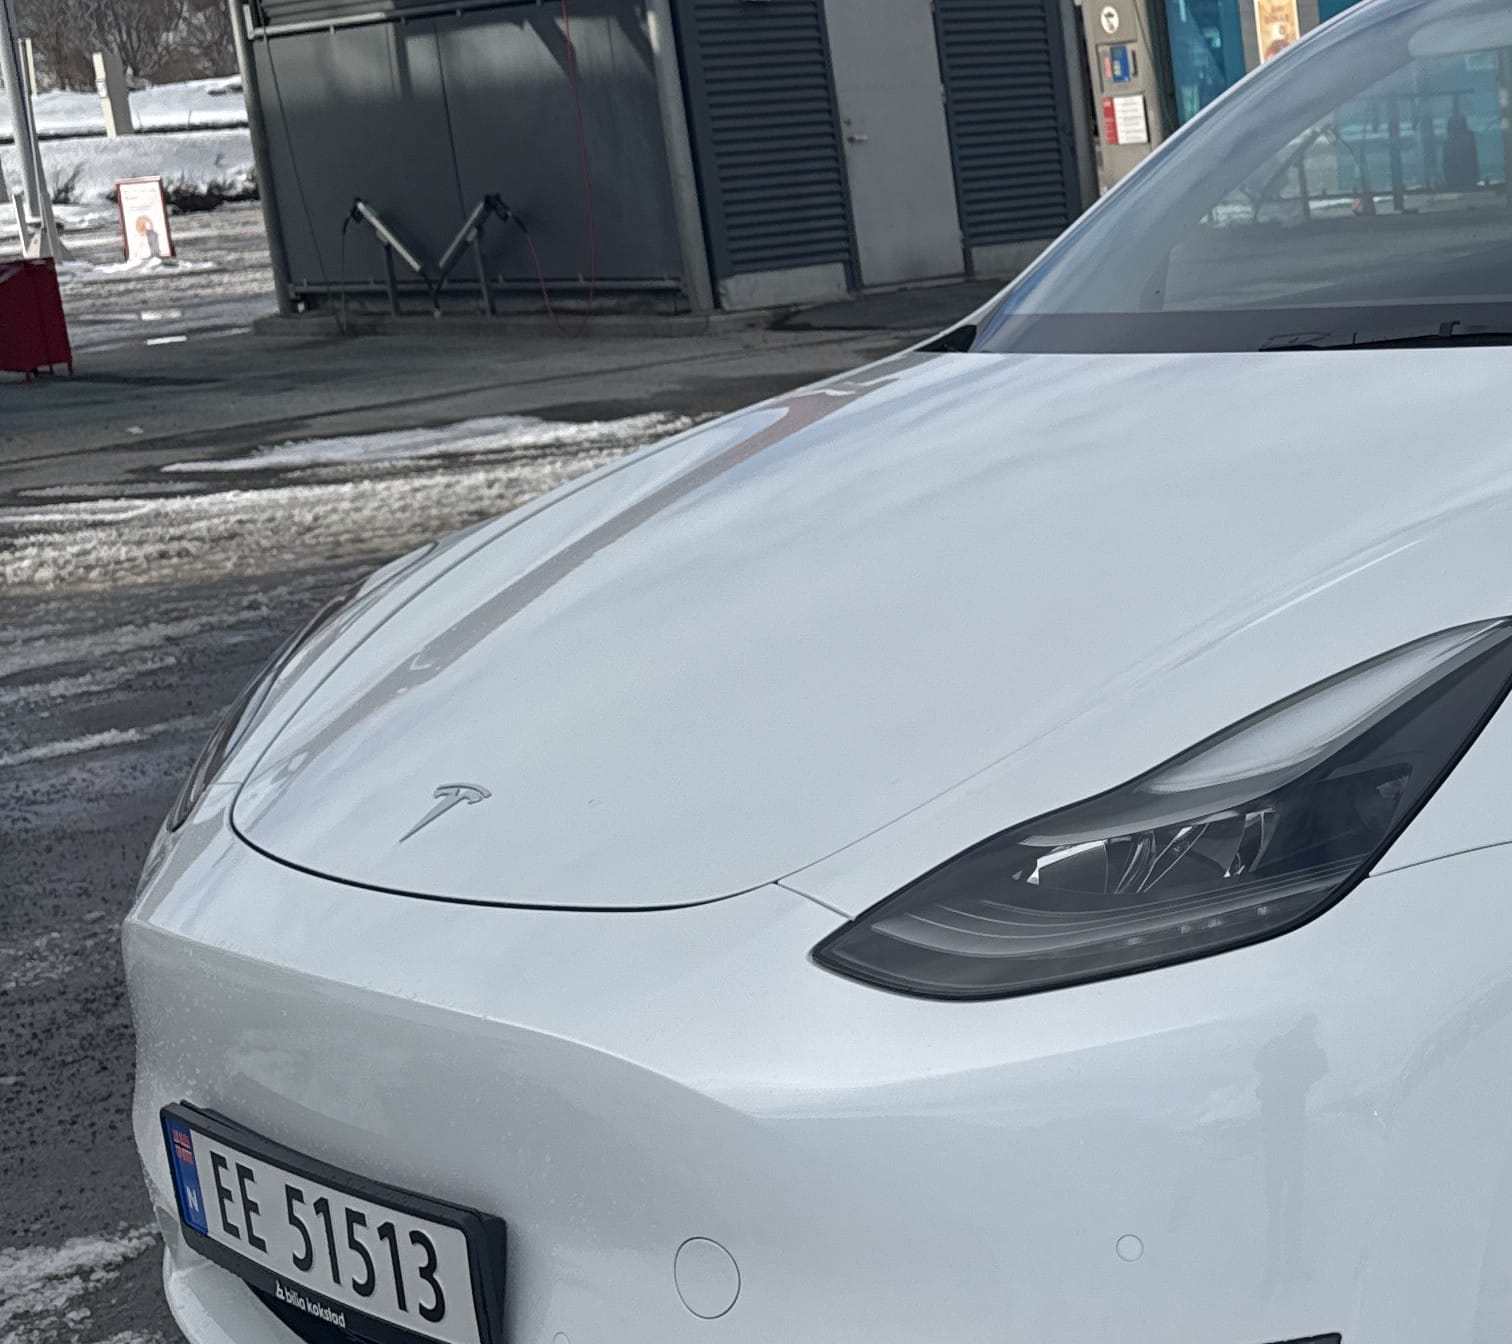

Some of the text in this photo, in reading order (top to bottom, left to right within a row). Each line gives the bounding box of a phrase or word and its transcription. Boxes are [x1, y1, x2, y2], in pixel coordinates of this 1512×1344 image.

[186, 1185, 200, 1213] N
[210, 1150, 446, 1324] EE 51513
[284, 1285, 346, 1329] bilia kokstad
